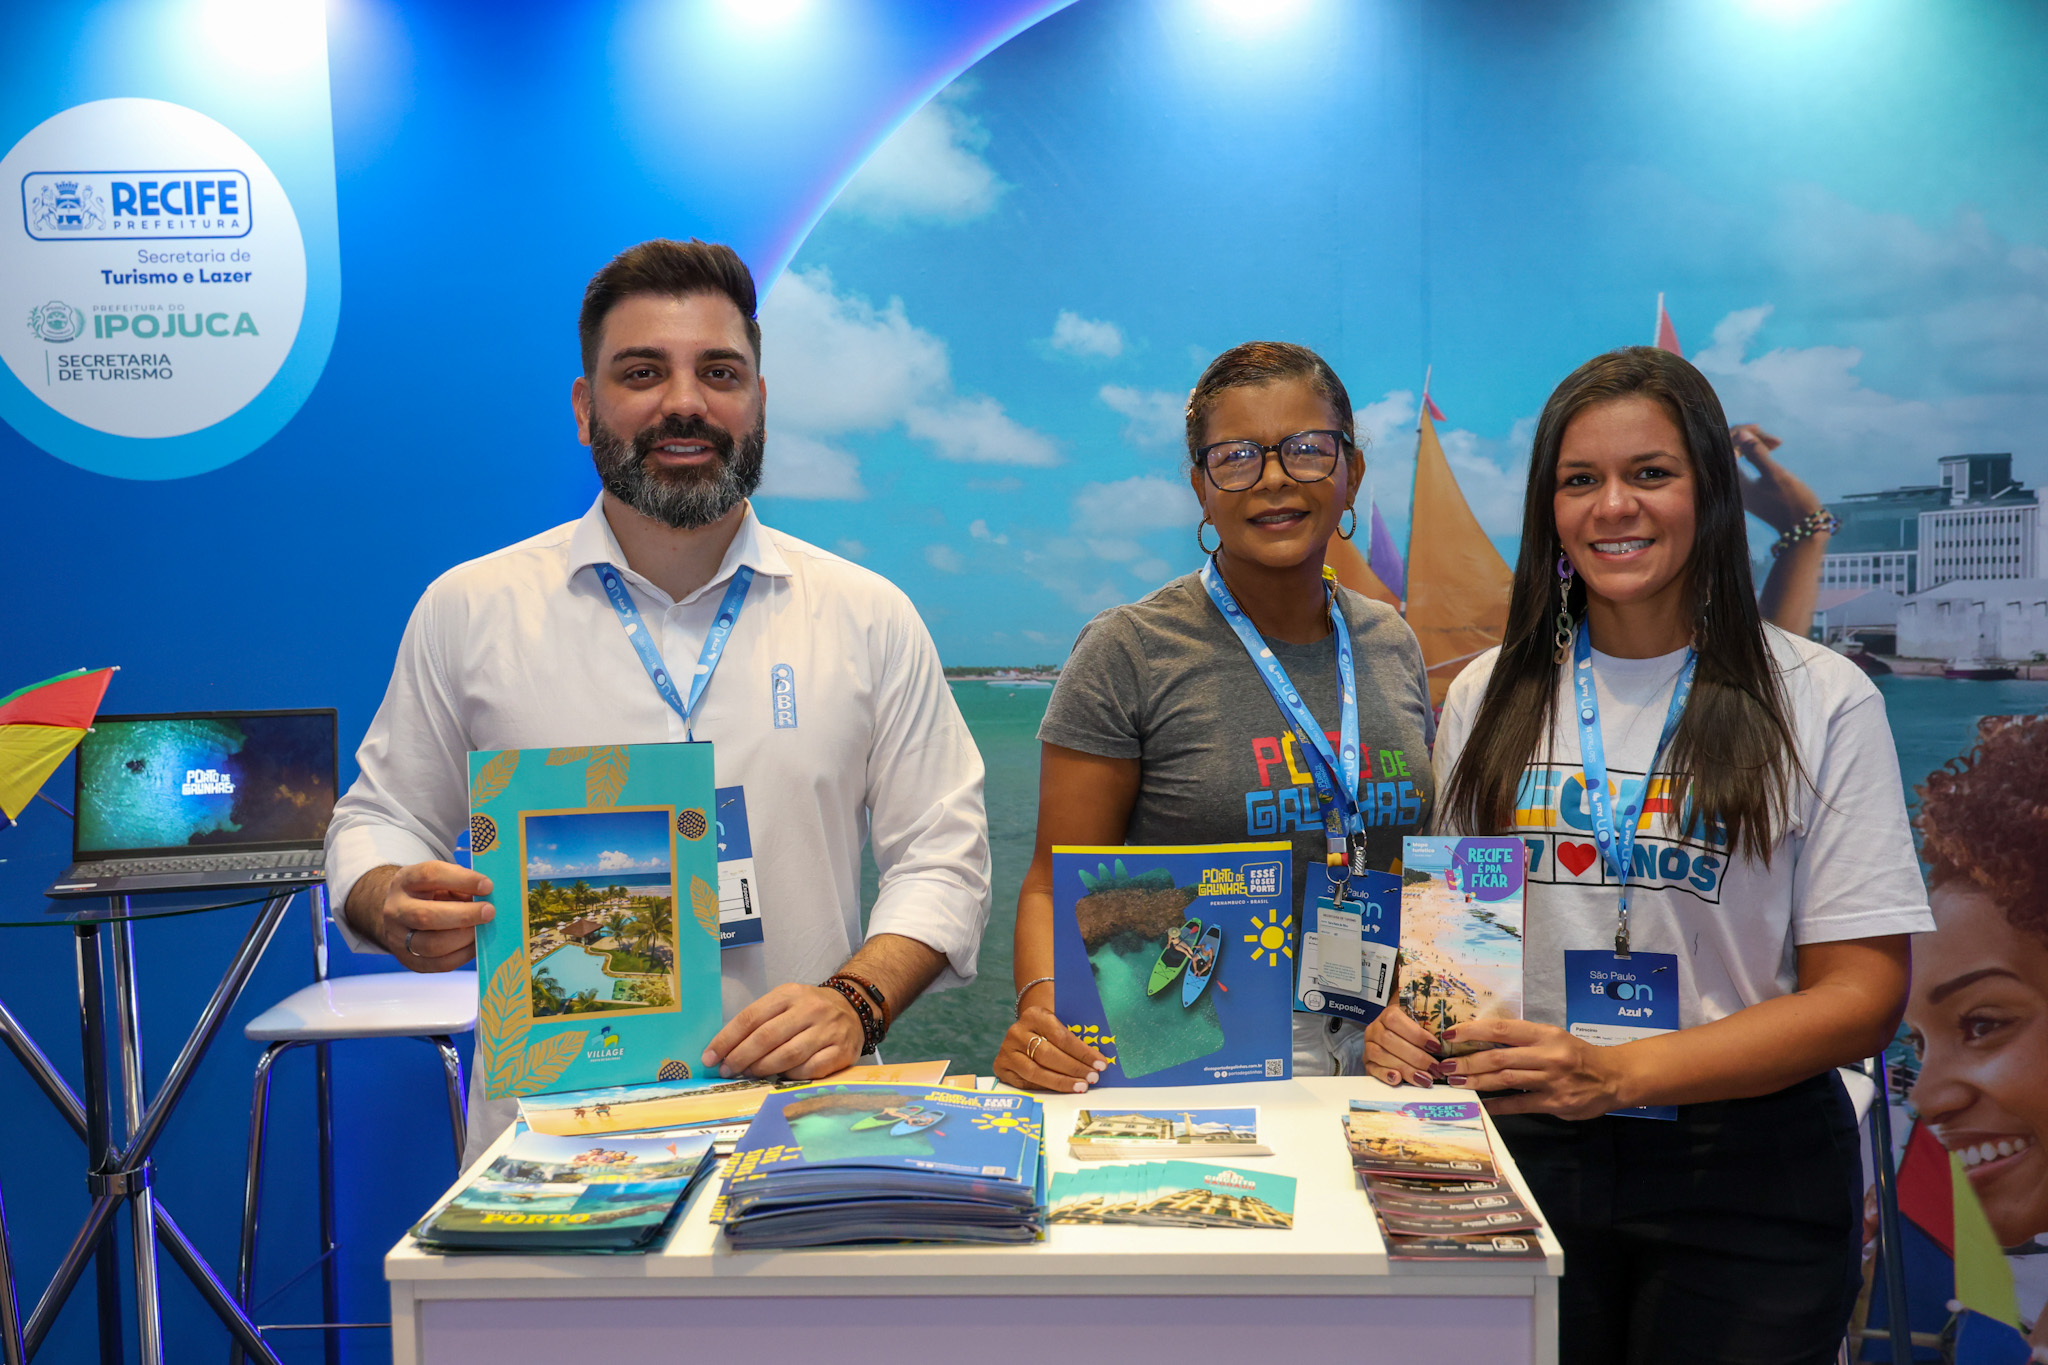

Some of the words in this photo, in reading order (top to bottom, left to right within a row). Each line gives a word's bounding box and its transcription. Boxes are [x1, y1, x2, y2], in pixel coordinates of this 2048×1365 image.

[111, 180, 239, 217] RECIFE
[113, 219, 240, 230] PREFEITURA
[137, 248, 226, 264] Secretaria
[230, 247, 251, 263] de
[101, 269, 178, 285] Turismo
[183, 272, 195, 283] e
[199, 268, 252, 284] Lazer
[92, 304, 164, 313] PREFEITURA
[169, 304, 186, 312] DO
[93, 312, 260, 339] IPOJUCA
[58, 353, 171, 368] SECRETARIA
[58, 369, 83, 381] DE
[90, 367, 173, 381] TURISMO
[711, 637, 720, 651] Azul
[1273, 670, 1286, 683] Azul
[1581, 684, 1589, 697] Azul
[1379, 750, 1411, 778] DE
[186, 769, 220, 783] PORTO
[220, 773, 231, 782] DE
[182, 781, 235, 795] GALINHAS
[1595, 802, 1604, 817] Azul
[1623, 829, 1631, 846] Azul
[1468, 847, 1513, 862] RECIFE
[1250, 868, 1275, 878] ESSE
[1478, 863, 1483, 873] É
[1485, 864, 1502, 873] PRA
[1202, 868, 1234, 884] PORTO
[1235, 873, 1245, 881] DE
[1471, 873, 1508, 888] FICAR
[1198, 882, 1248, 896] GALINHAS
[1250, 885, 1275, 893] PORTO
[1590, 970, 1608, 979] São
[1611, 971, 1636, 981] Paulo
[1590, 982, 1604, 994] tá
[1328, 1000, 1366, 1015] Expositor
[1618, 1007, 1641, 1017] Azul
[587, 1048, 624, 1058] VILLAGE
[481, 1213, 590, 1224] PORTO
